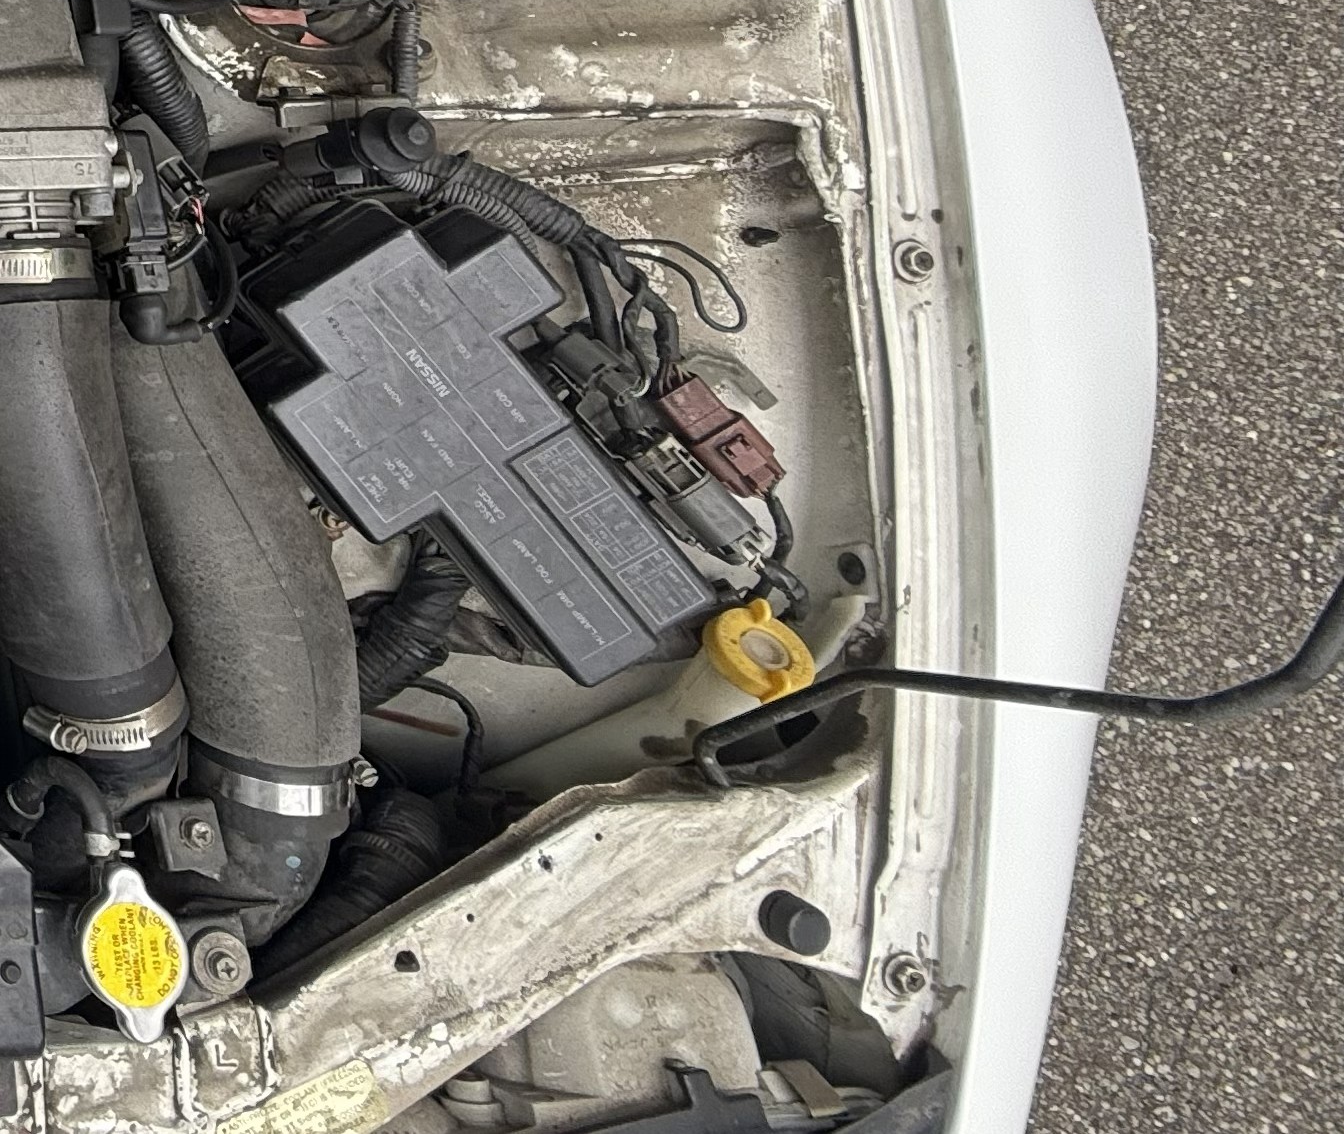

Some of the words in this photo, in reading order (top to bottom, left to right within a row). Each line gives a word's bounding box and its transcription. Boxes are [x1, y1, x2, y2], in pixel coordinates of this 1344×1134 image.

[404, 345, 451, 399] NISSAN
[473, 482, 506, 521] CANCEL
[511, 535, 538, 565] LAMP
[534, 562, 554, 585] FOG
[112, 934, 120, 946] OR
[119, 918, 128, 944] WHEN
[125, 908, 138, 948] COOLANT
[133, 952, 143, 1000] CHANGING
[152, 960, 161, 969] 13
[157, 982, 170, 996] DO
[167, 960, 178, 983] NOT
